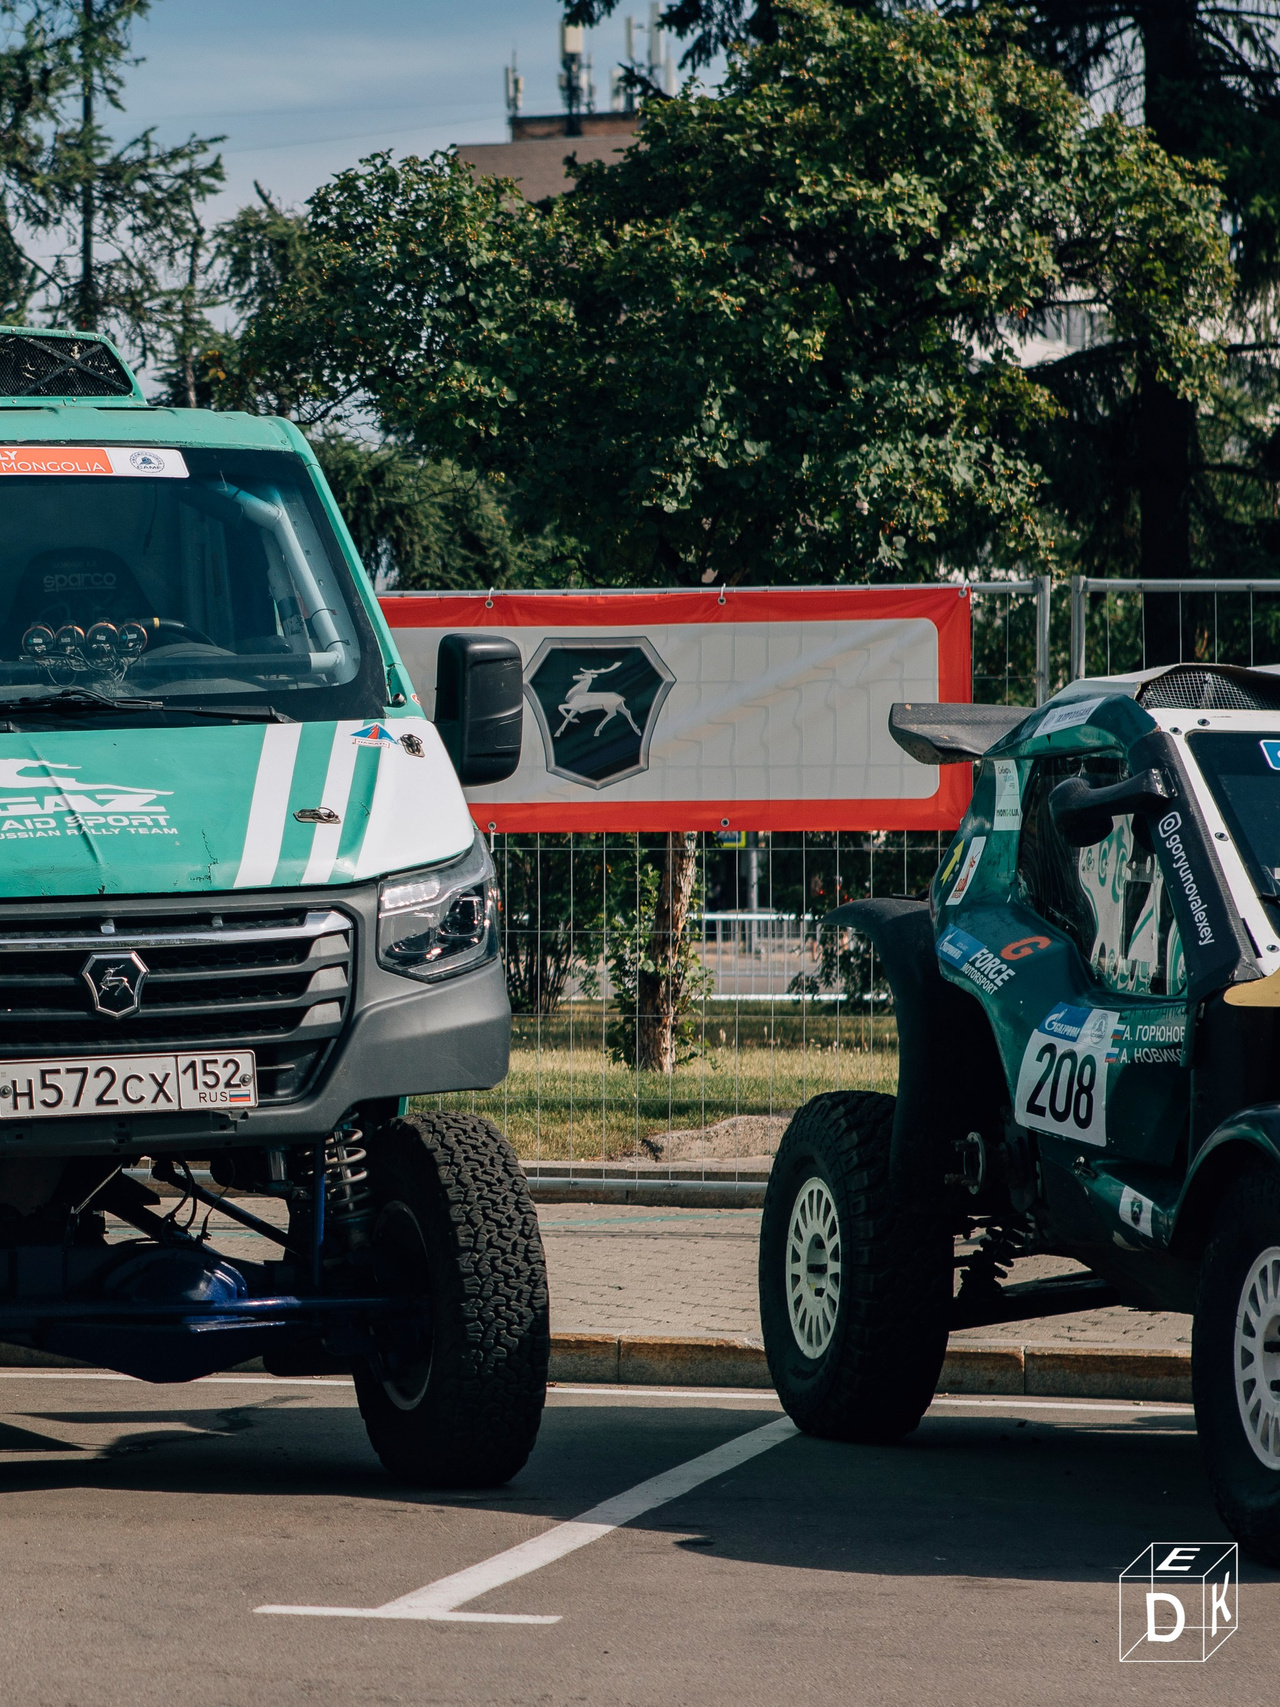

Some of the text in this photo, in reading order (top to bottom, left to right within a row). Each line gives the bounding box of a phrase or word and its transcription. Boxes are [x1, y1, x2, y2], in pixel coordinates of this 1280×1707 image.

[1, 461, 106, 473] MONGOLIA
[43, 572, 116, 592] sparco
[64, 815, 170, 827] SPORT
[66, 827, 121, 836] RALLY
[126, 827, 179, 836] TEAM
[1166, 834, 1215, 946] goryunovalexey
[1000, 935, 1052, 960] G
[960, 962, 999, 995] MOTORSPORT
[968, 948, 1016, 987] FORCE
[1053, 1021, 1082, 1039] GAZPROM
[181, 1057, 243, 1091] 152
[1025, 1042, 1097, 1130] 208
[198, 1091, 228, 1104] RUS
